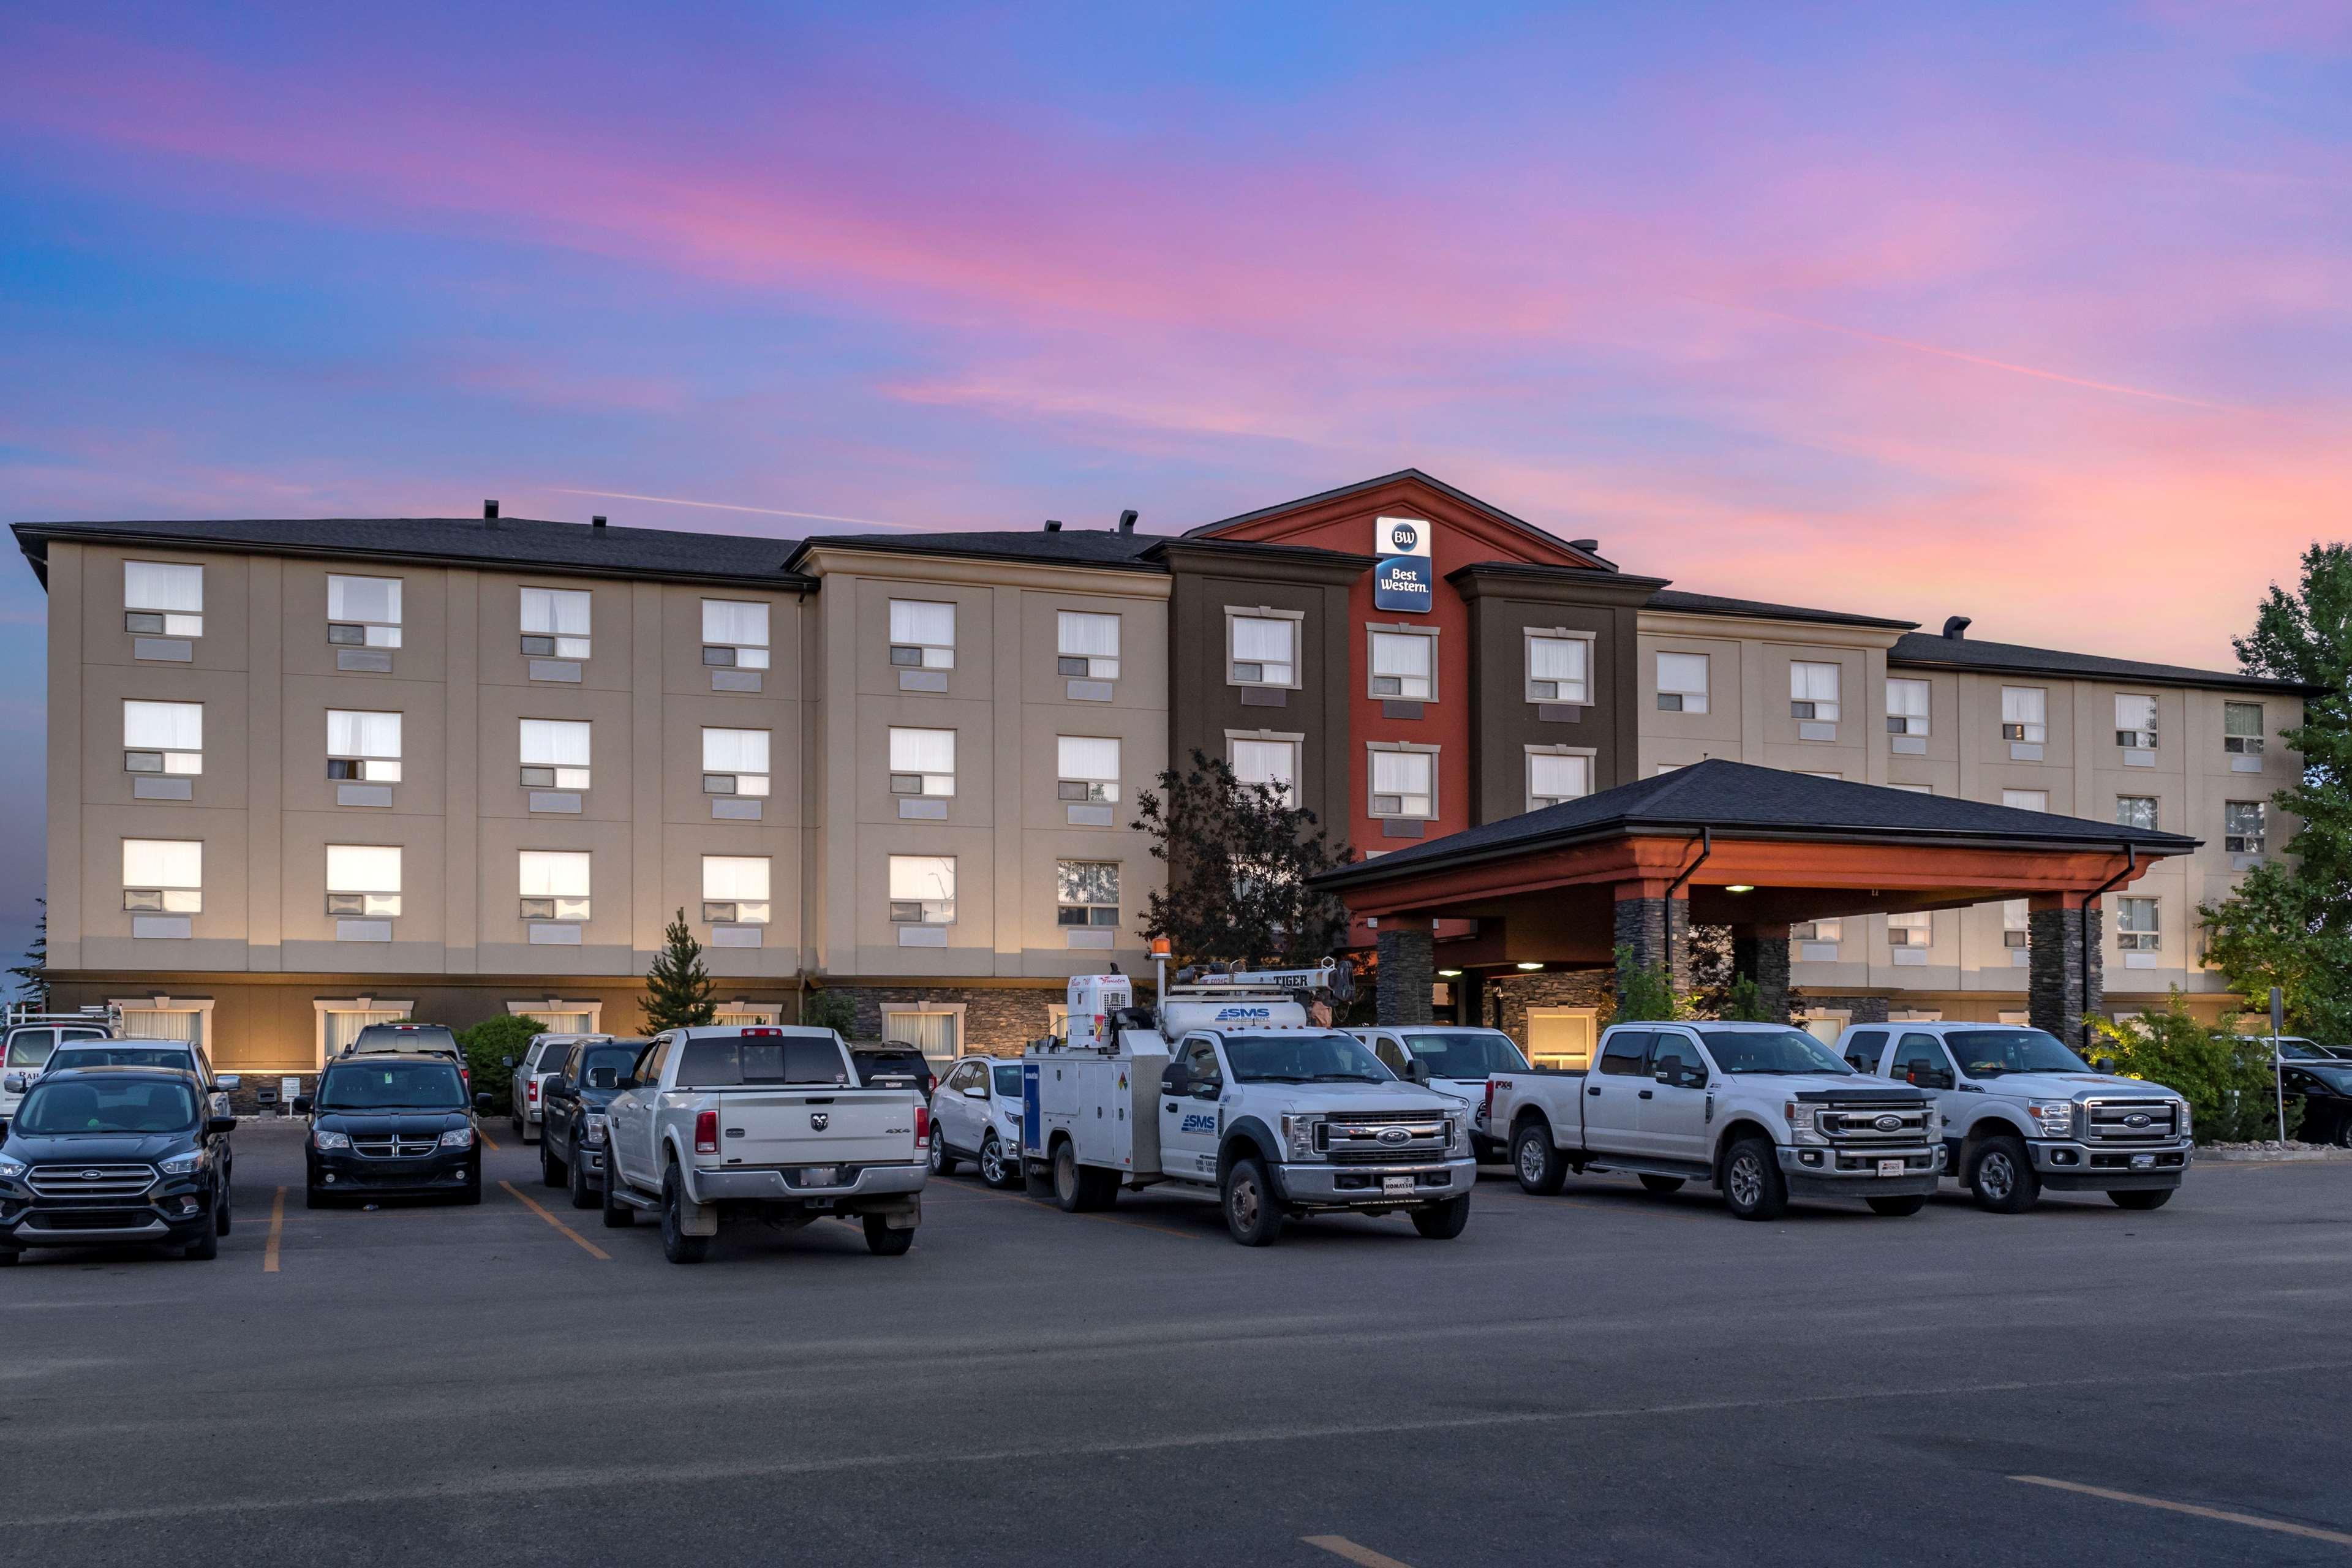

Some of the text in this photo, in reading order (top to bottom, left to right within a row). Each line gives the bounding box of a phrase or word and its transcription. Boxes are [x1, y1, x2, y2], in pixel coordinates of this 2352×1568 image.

[1394, 531, 1415, 544] BW
[1392, 568, 1417, 581] Best
[1274, 975, 1308, 987] TIGER
[1227, 1008, 1270, 1017] SMS
[1495, 1080, 1512, 1090] FX4
[1189, 1115, 1215, 1129] SMS
